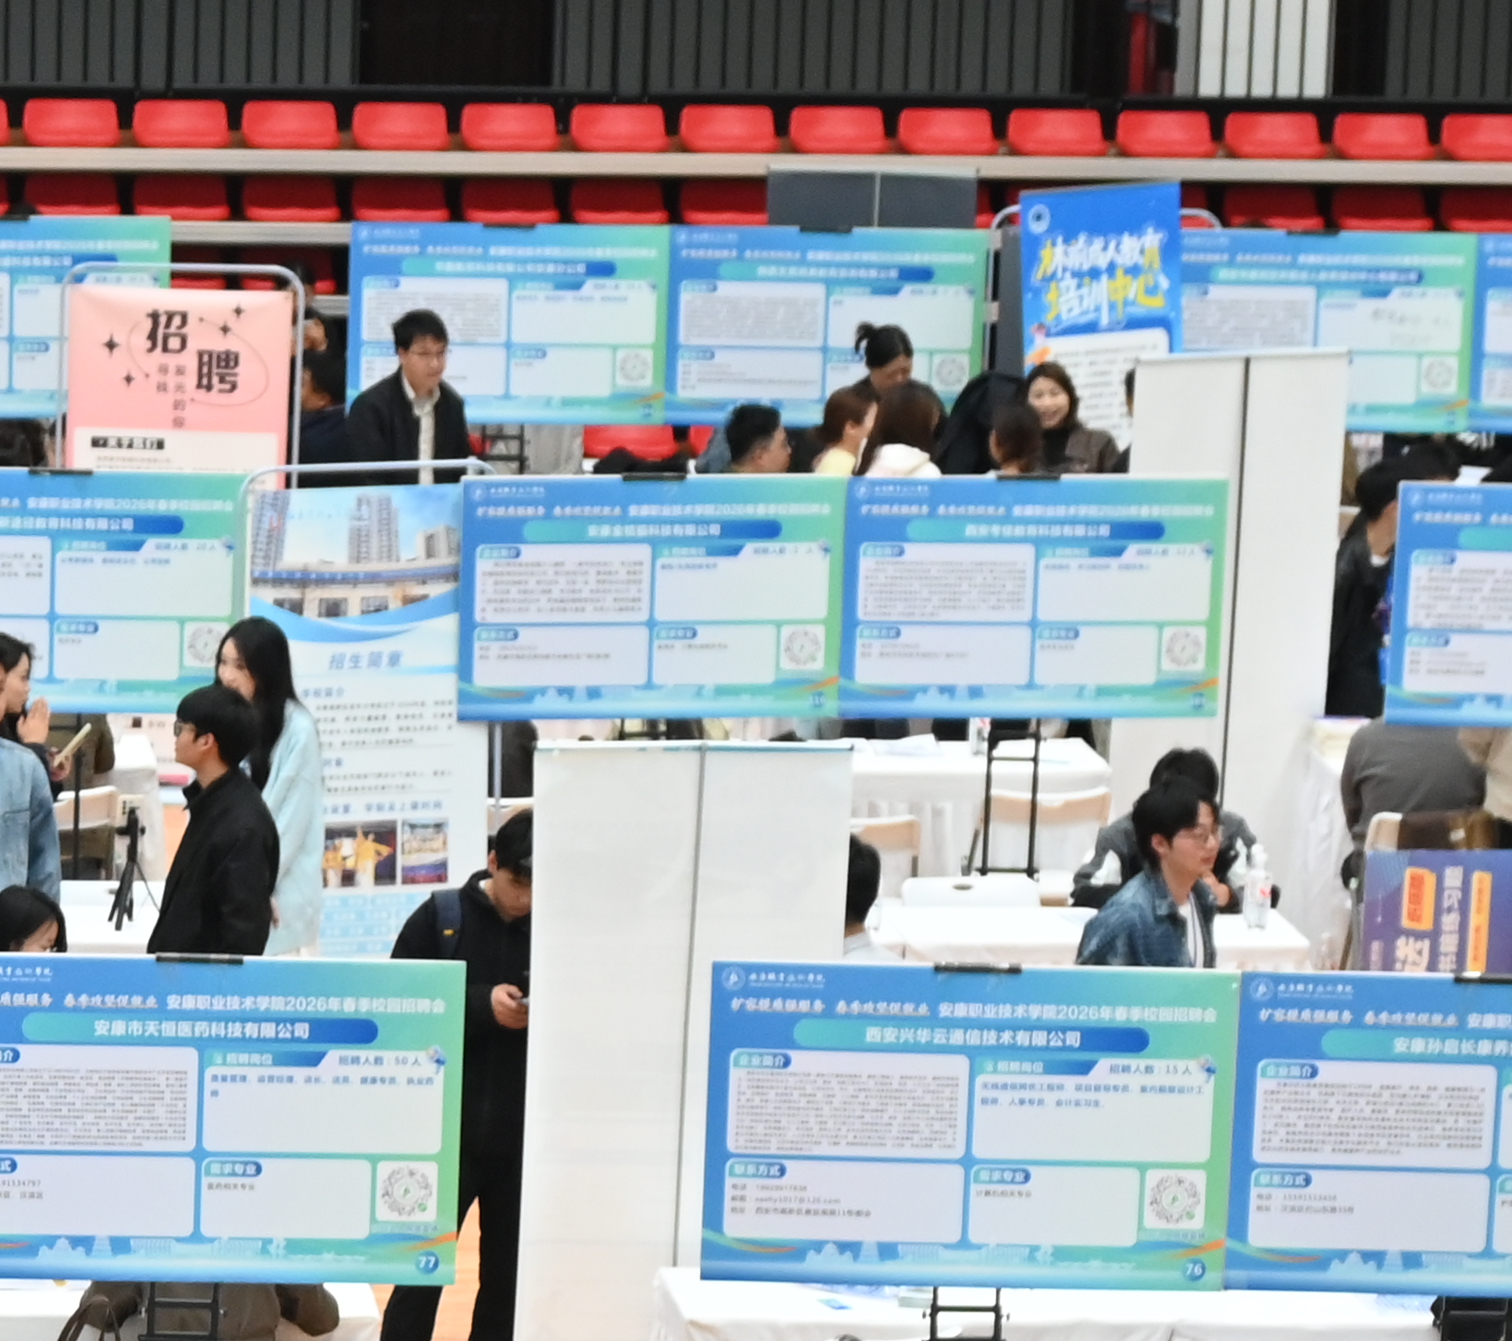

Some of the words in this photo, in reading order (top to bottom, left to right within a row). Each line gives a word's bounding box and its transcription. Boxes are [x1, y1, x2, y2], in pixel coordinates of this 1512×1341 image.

[94, 1020, 309, 1040] 安康市天恒医药科技有限公司
[866, 1027, 1082, 1048] 西安兴华云通信技术有限公司
[417, 1255, 436, 1269] 77
[1185, 1263, 1203, 1277] 76
